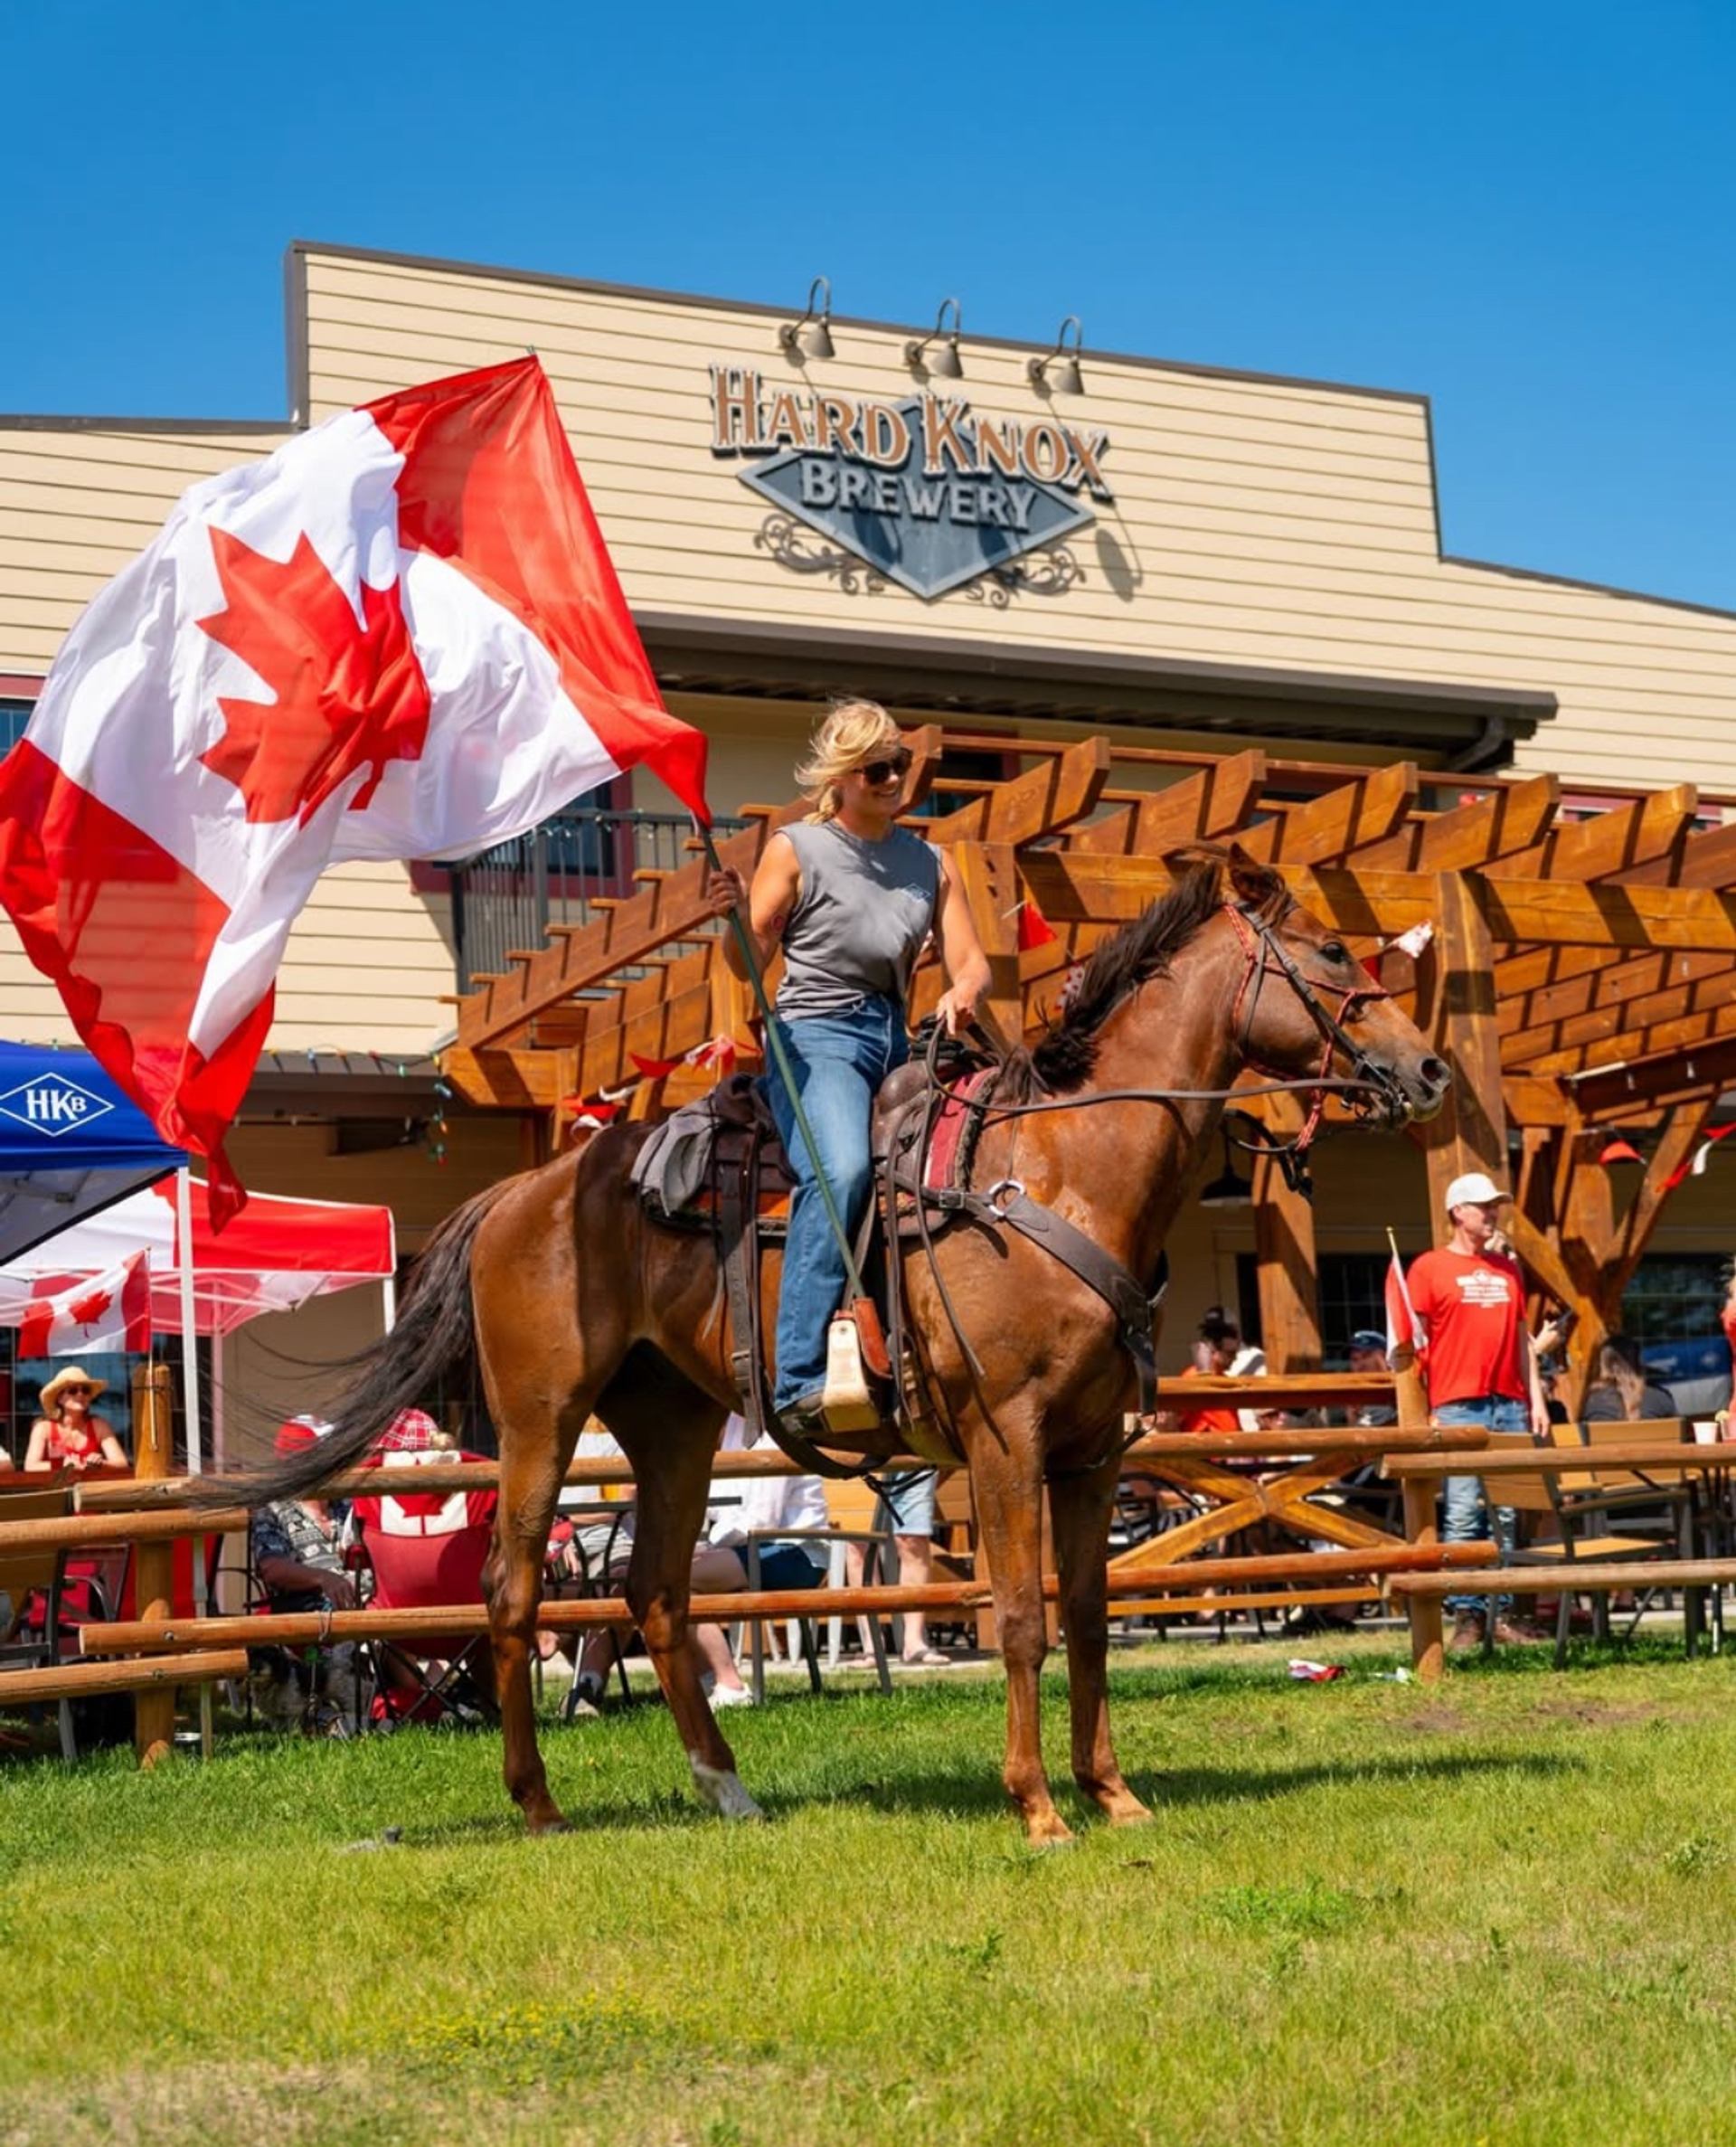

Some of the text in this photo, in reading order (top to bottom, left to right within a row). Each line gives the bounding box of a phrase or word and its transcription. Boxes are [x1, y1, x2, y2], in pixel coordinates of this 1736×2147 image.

[709, 364, 1112, 500] HARD KNOX
[799, 459, 1037, 531] BREWERY
